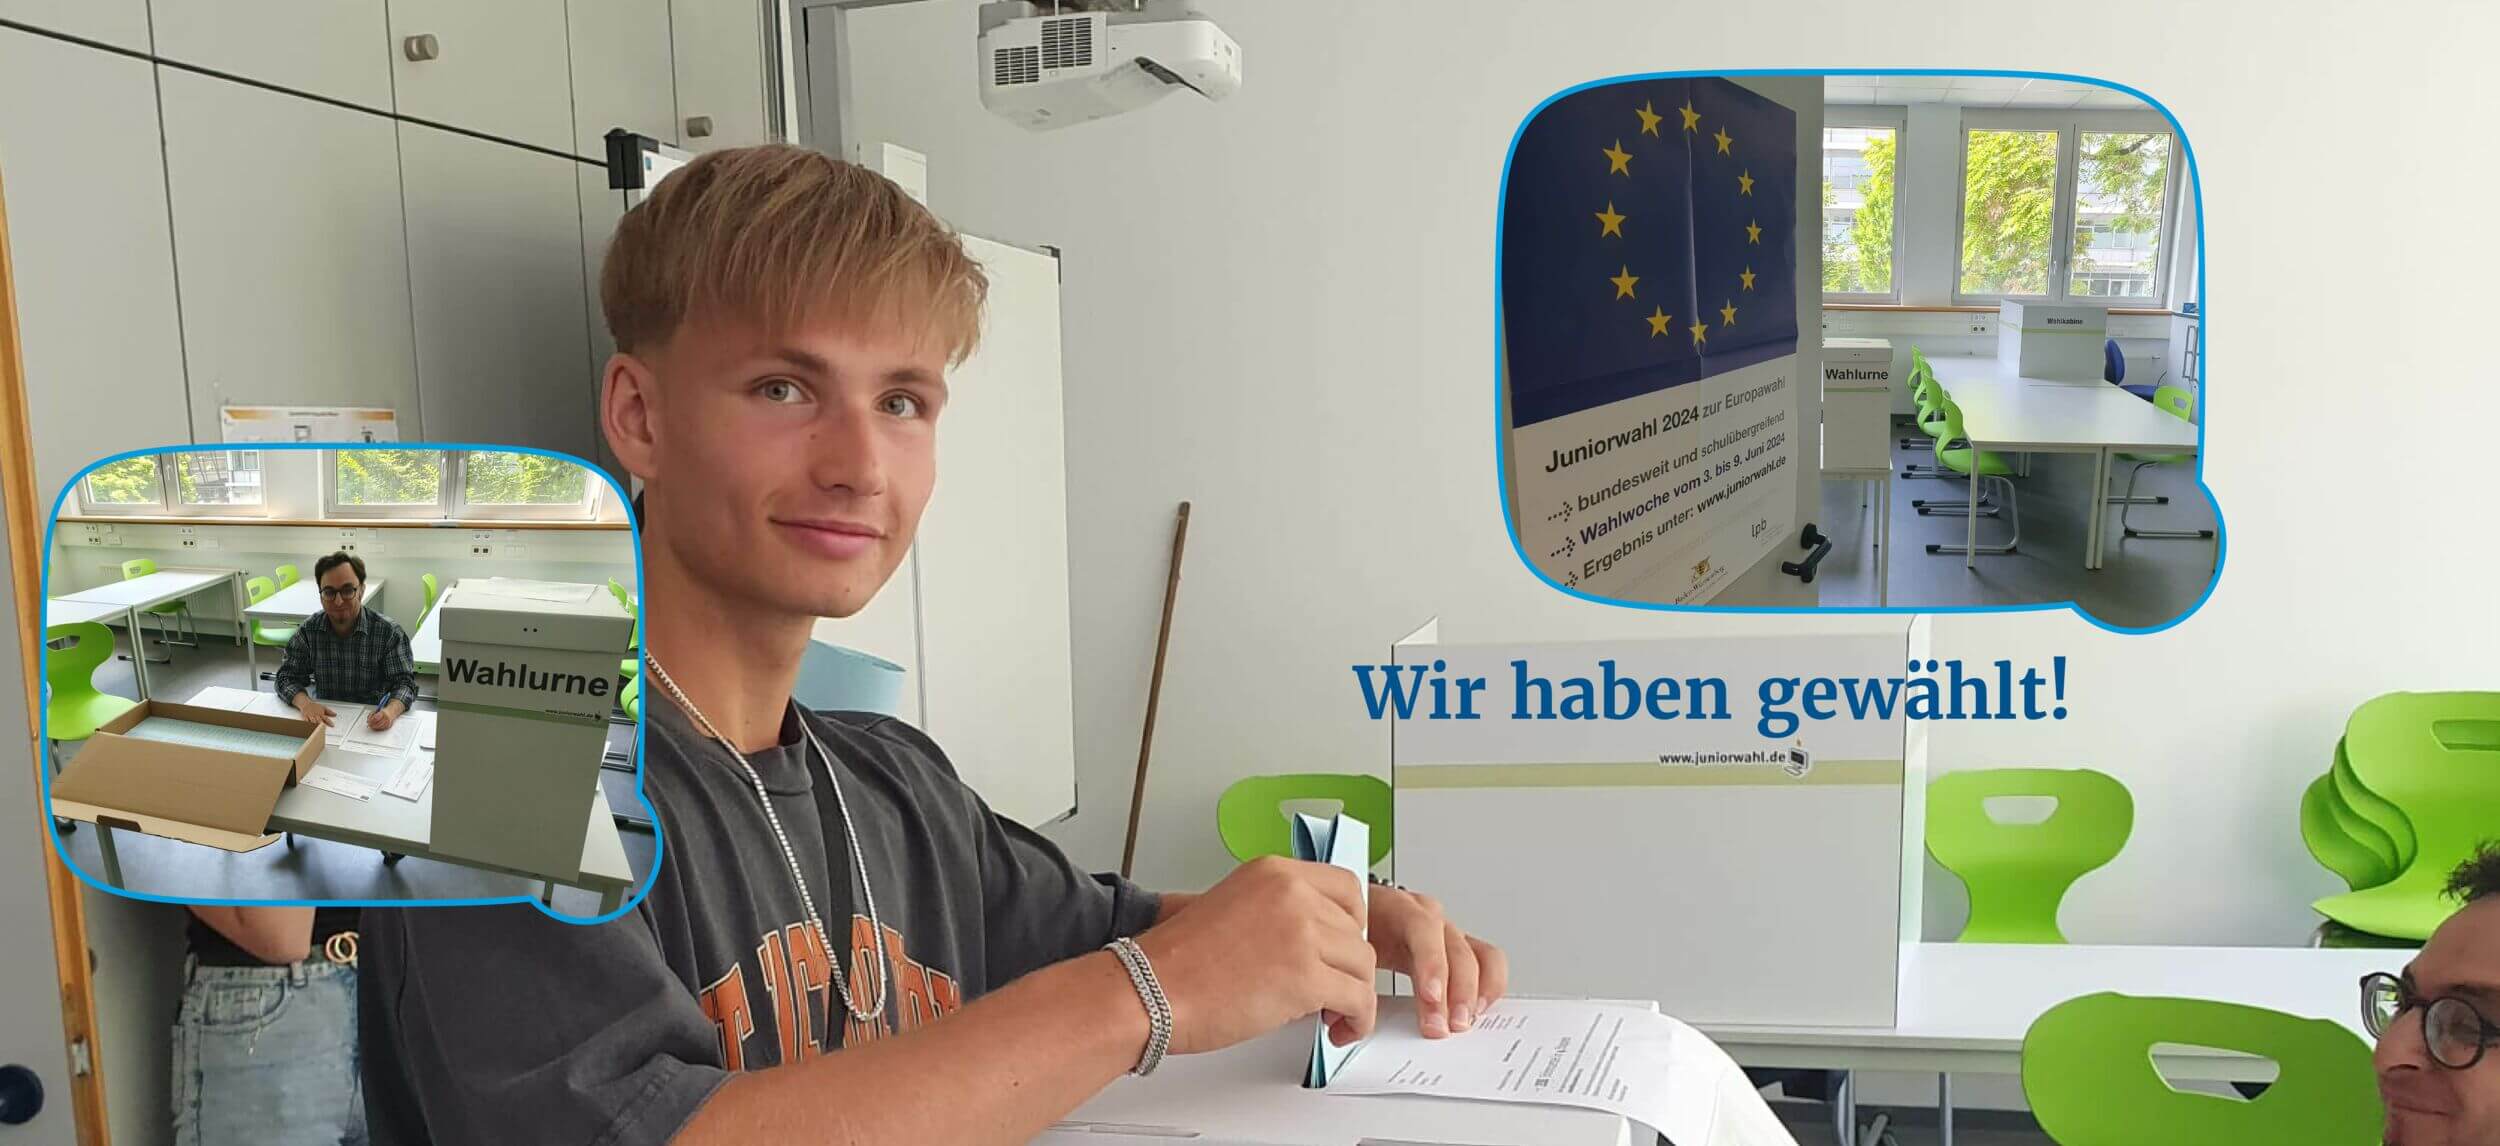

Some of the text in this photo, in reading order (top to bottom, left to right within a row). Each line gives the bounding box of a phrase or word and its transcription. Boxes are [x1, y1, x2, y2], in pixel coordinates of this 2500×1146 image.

[1825, 368, 1889, 380] Wahlurne
[1545, 376, 1786, 473] Juniorwahl 2024 zur Europawahl
[1578, 410, 1785, 512] bundesweit und schulübergreifend
[1580, 432, 1785, 545] Wahlwoche vom 3. bis 9. Juni 2024
[1583, 456, 1786, 580] Ergebnis unter: www.juniorwahl.de
[446, 657, 609, 697] Wahlurne
[1659, 751, 1786, 766] www.juniorwahl.de
